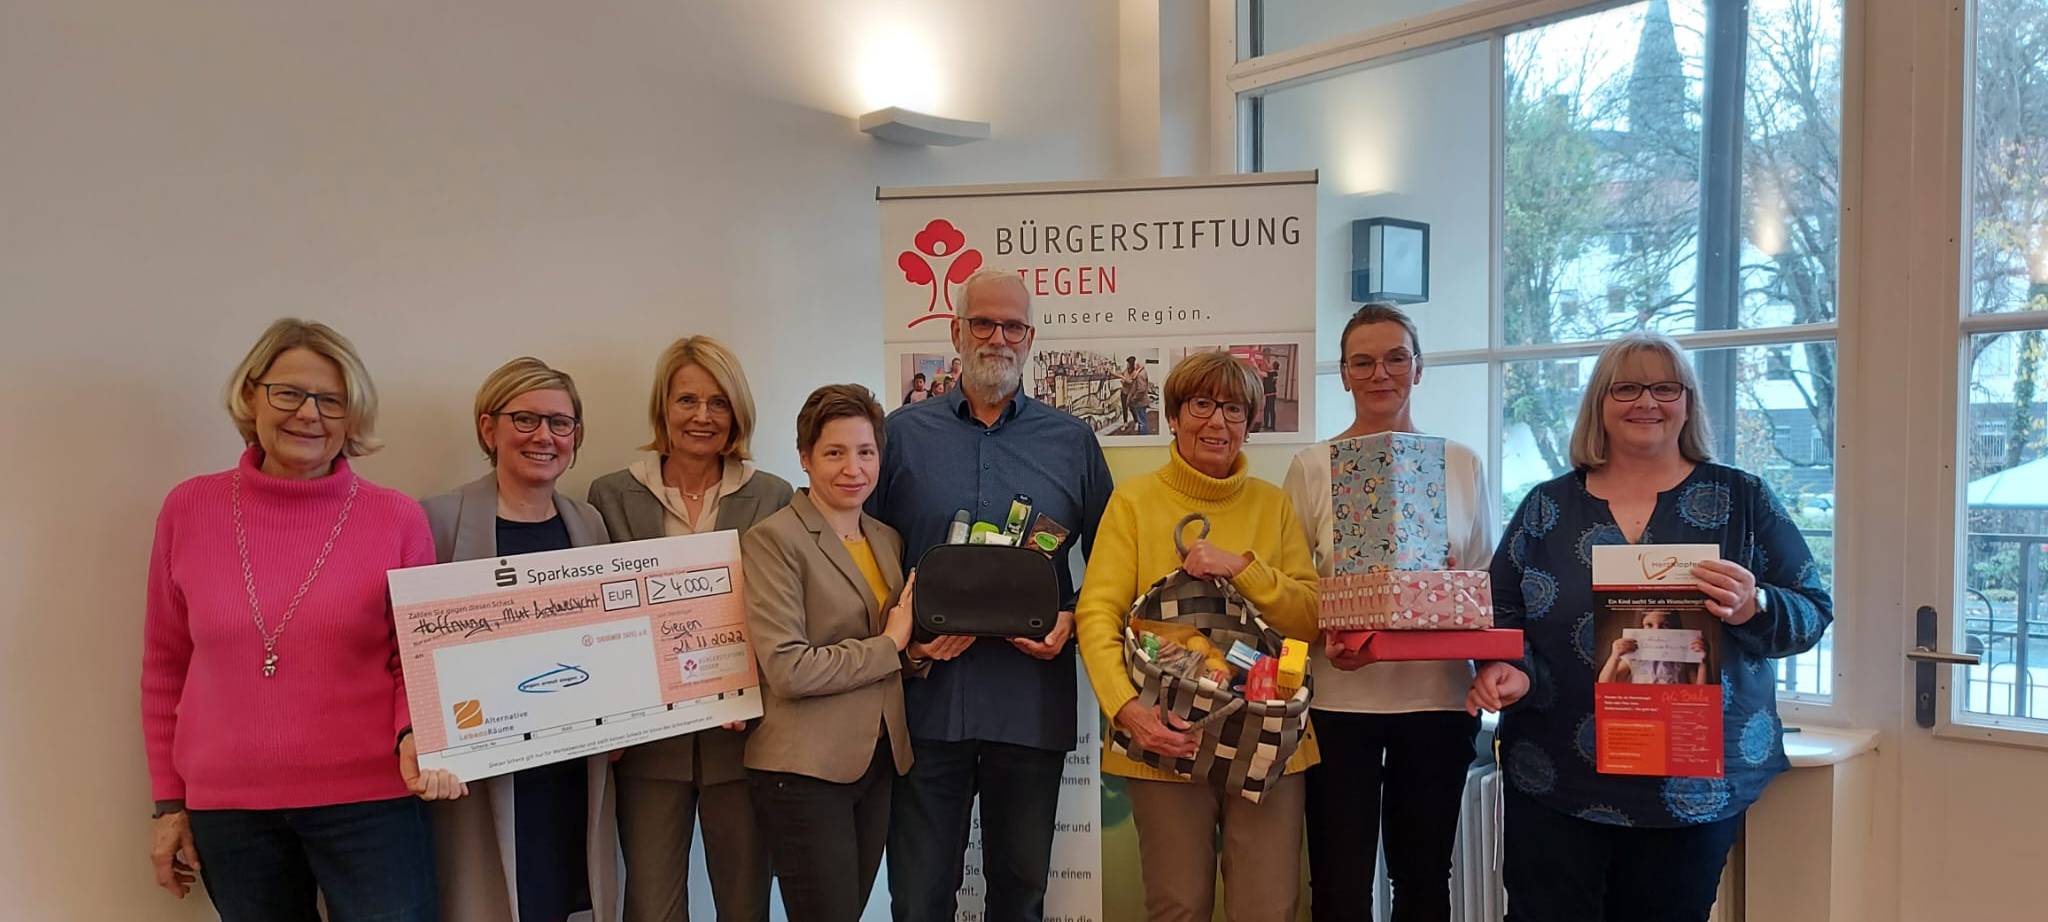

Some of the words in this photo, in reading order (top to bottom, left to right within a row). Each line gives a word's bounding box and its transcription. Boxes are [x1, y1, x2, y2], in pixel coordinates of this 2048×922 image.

[997, 216, 1301, 255] BÜRGERSTIFTUNG
[1017, 266, 1117, 296] EGEN
[1043, 311, 1113, 325] unsere
[1128, 306, 1212, 326] Region.
[527, 562, 604, 585] Sparkasse
[612, 556, 659, 574] Siegen
[608, 589, 634, 602] EUR
[661, 620, 702, 640] Siegen
[711, 630, 747, 645] 2022
[485, 711, 528, 724] Alternative
[1079, 732, 1090, 744] uf
[1072, 821, 1091, 832] und
[1061, 867, 1092, 879] einem
